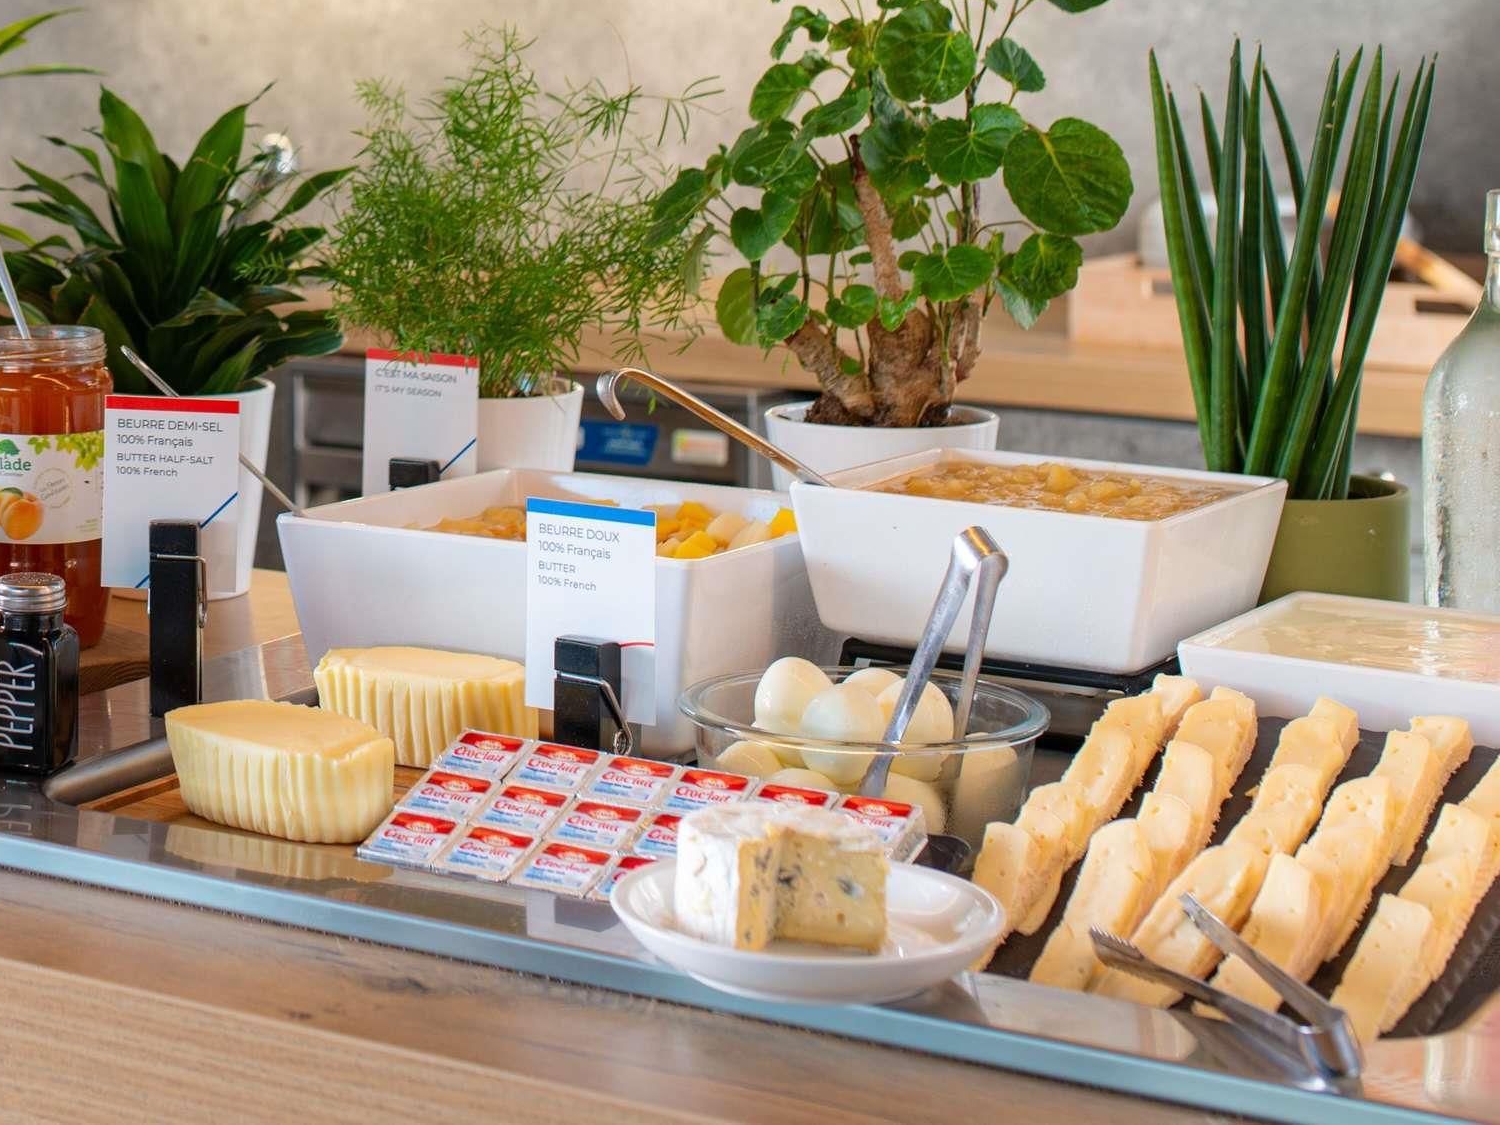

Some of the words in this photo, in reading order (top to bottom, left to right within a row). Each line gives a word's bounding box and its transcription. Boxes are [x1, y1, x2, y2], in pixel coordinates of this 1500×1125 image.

[403, 371, 419, 379] MA
[420, 372, 457, 383] SAISON
[392, 386, 405, 394] MY
[407, 387, 442, 397] SEASON
[117, 418, 165, 430] BEURRE
[168, 420, 223, 432] DEMI-SEL
[117, 434, 145, 444] 100%
[147, 436, 193, 448] Français
[117, 453, 156, 463] BUTTER
[159, 454, 215, 465] HALF-SALT
[116, 466, 141, 475] 100%
[143, 467, 178, 477] French
[539, 523, 584, 538] BEURRE
[586, 528, 620, 542] DOUX
[538, 540, 565, 553] 100%
[567, 544, 611, 560] Français
[538, 560, 576, 573] BUTTER
[538, 575, 562, 587] 100%
[564, 578, 597, 591] French
